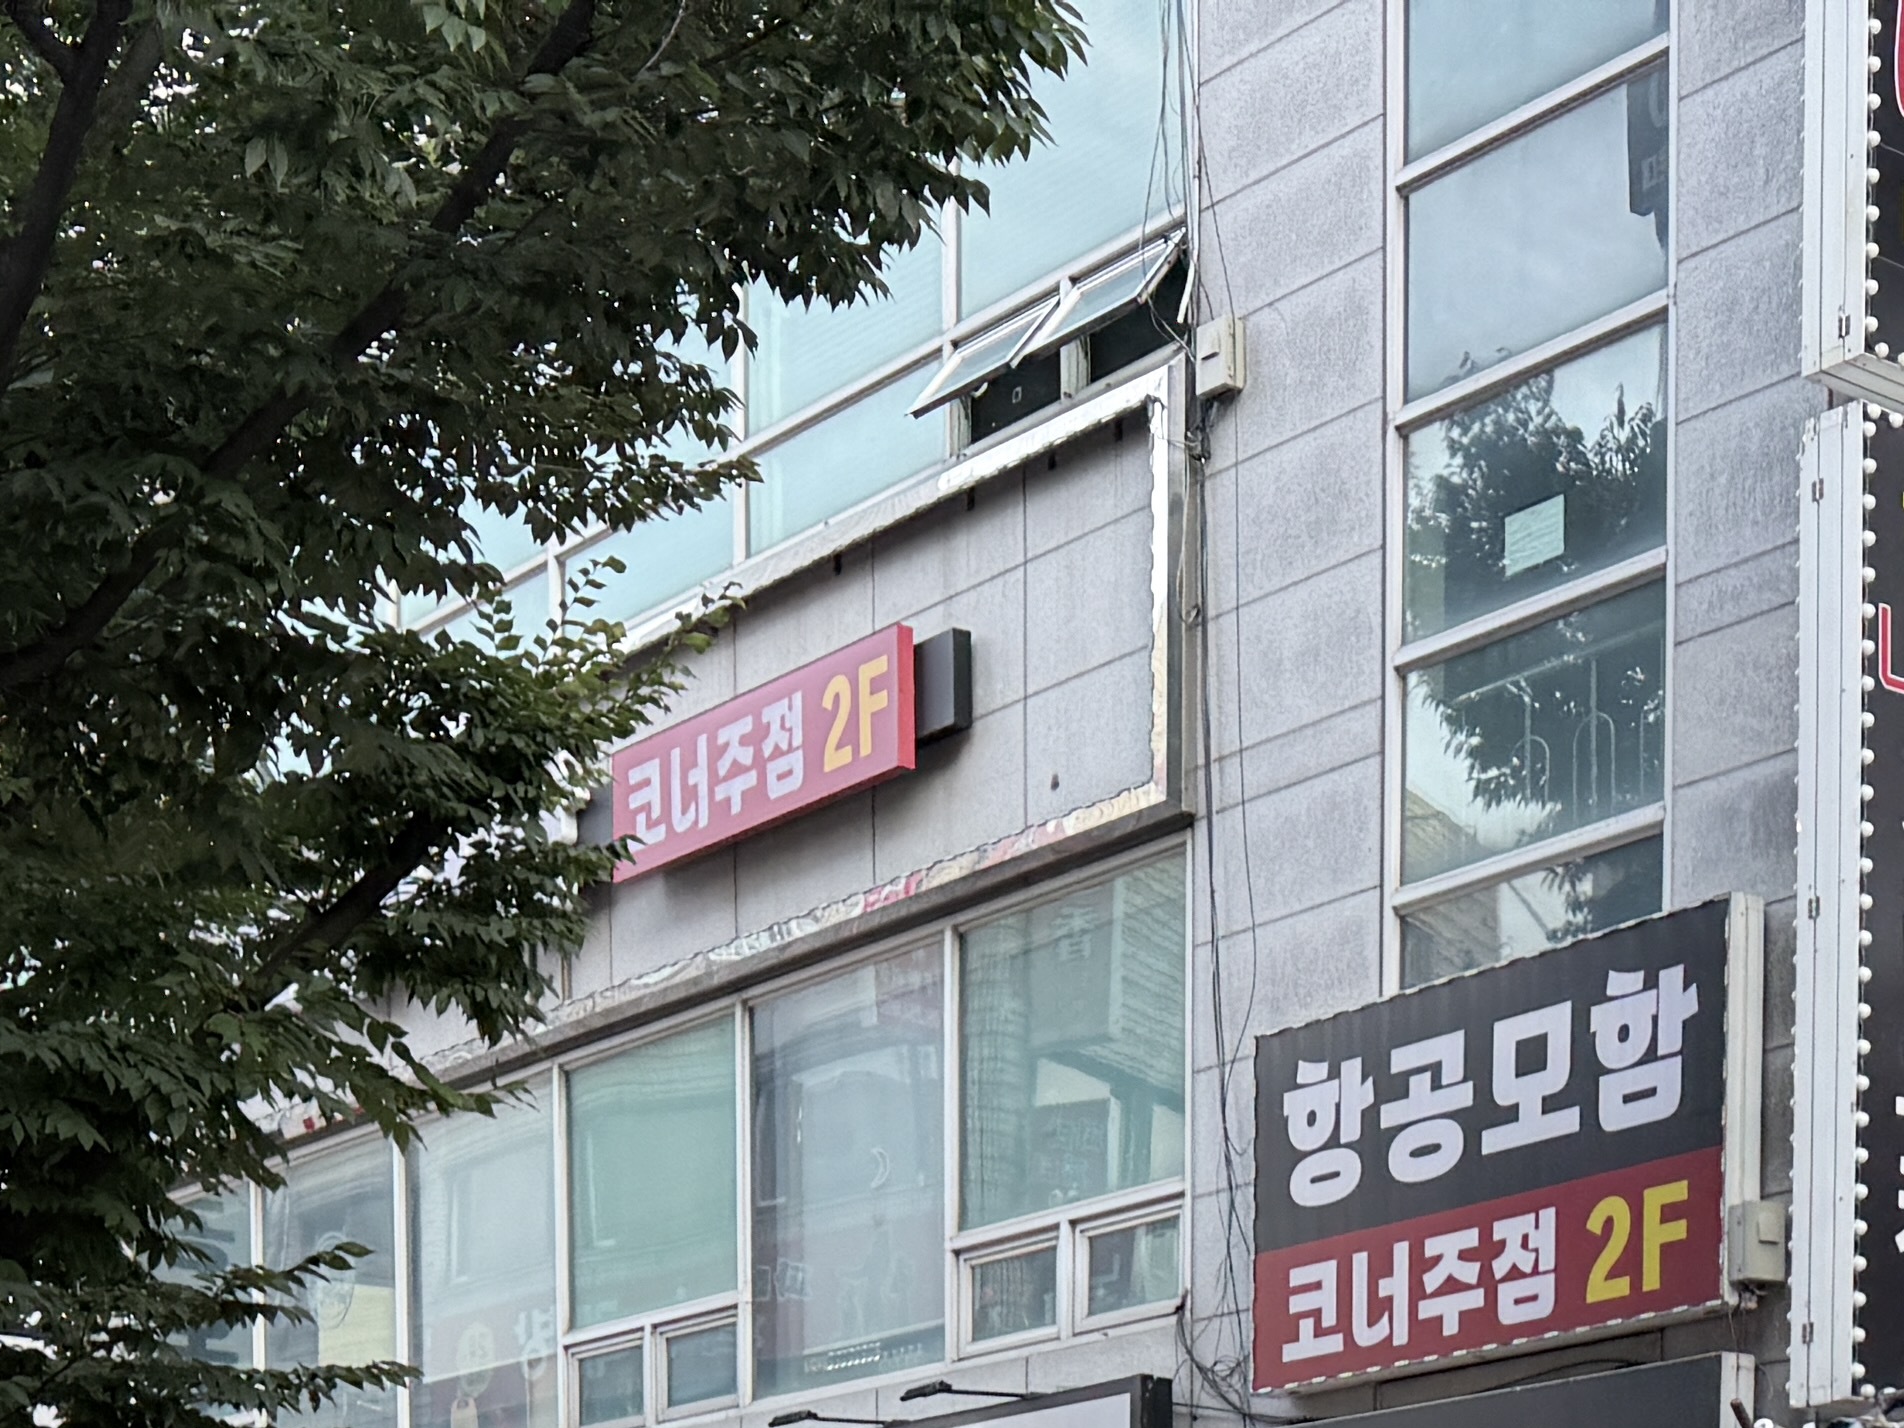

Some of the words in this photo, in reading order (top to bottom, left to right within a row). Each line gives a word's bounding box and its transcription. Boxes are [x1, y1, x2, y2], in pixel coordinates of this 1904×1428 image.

[626, 690, 805, 853] 코너주점
[822, 653, 889, 774] 2F
[1283, 963, 1700, 1208] 항공모함
[1282, 1205, 1557, 1363] 코너주점
[1586, 1180, 1689, 1304] 2F
